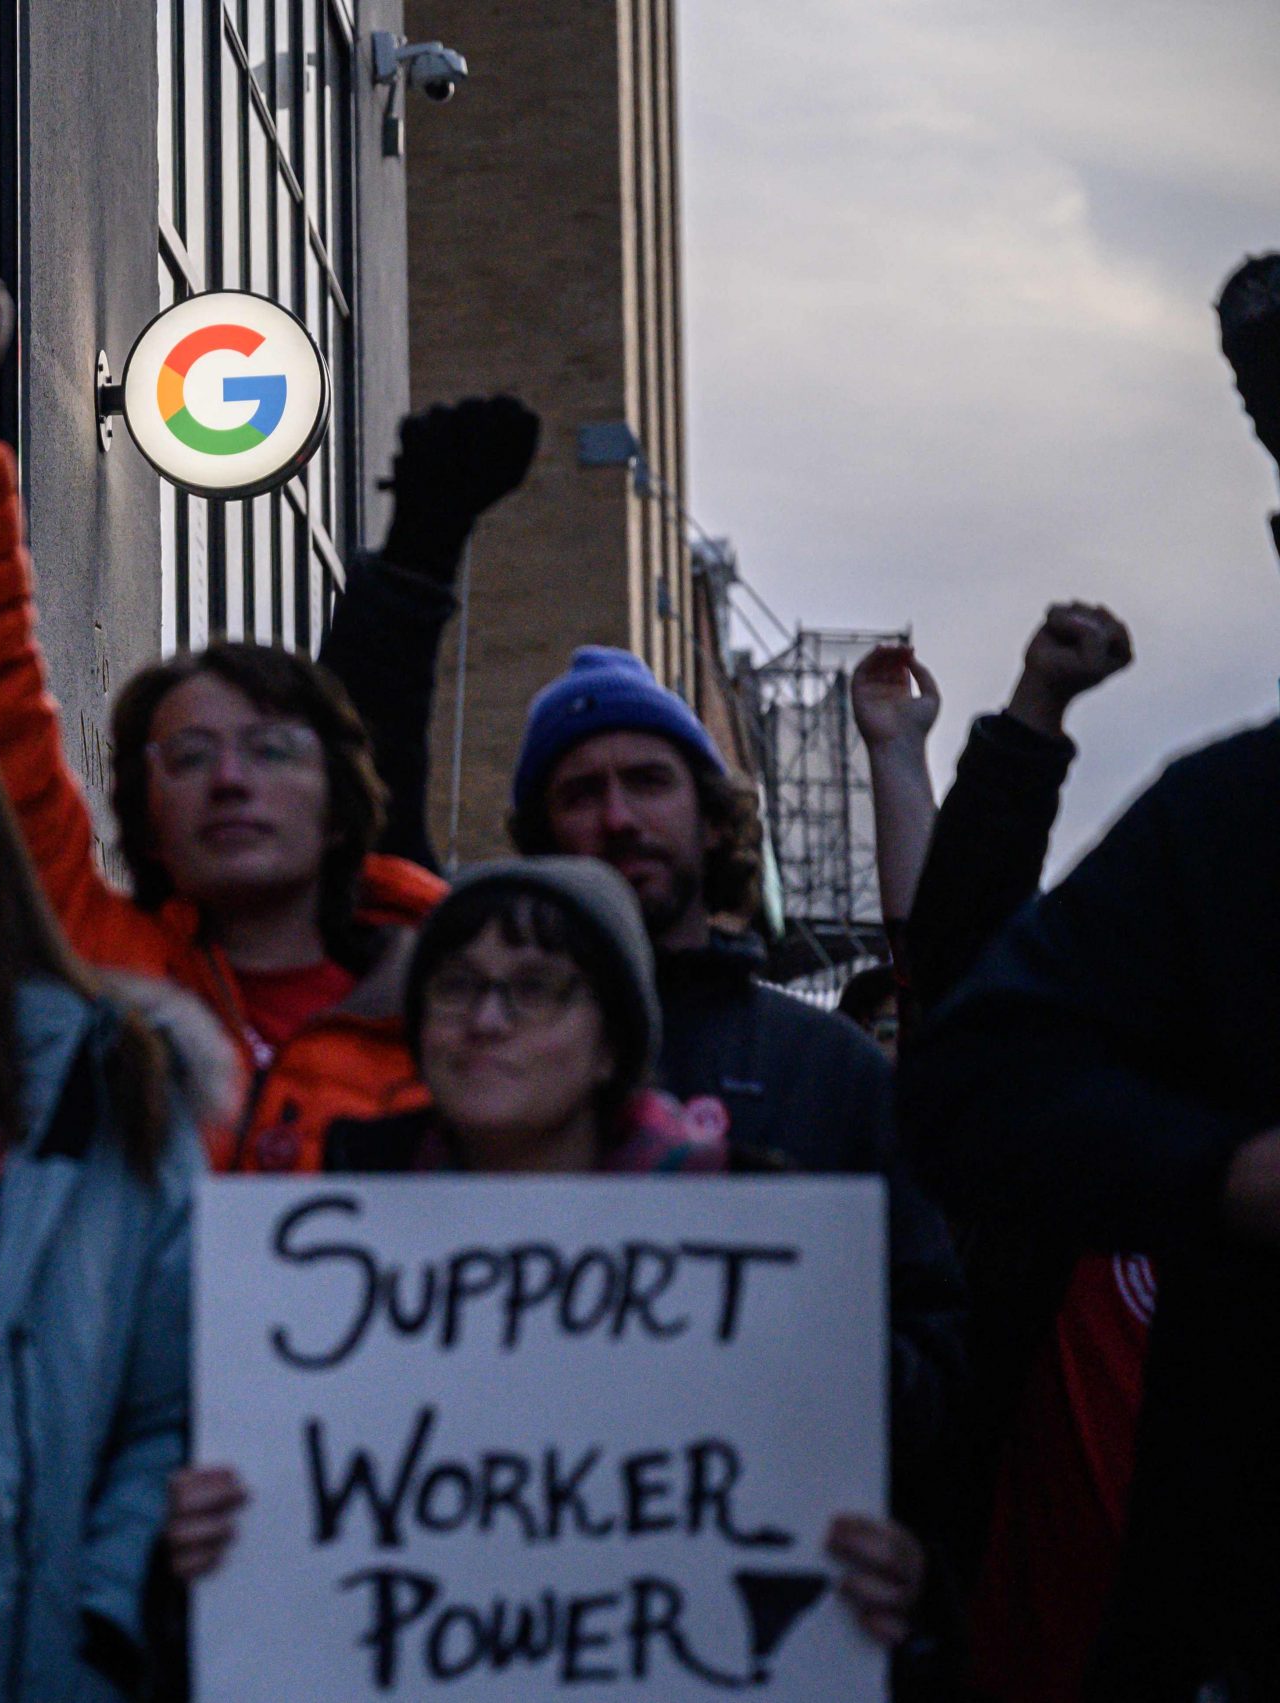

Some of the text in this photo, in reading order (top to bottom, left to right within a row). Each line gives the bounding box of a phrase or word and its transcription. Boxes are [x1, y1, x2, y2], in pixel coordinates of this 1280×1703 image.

[158, 324, 287, 455] G
[272, 1195, 798, 1370] SUPPORT
[305, 1404, 794, 1548] WORKER
[339, 1565, 830, 1690] POWER!
